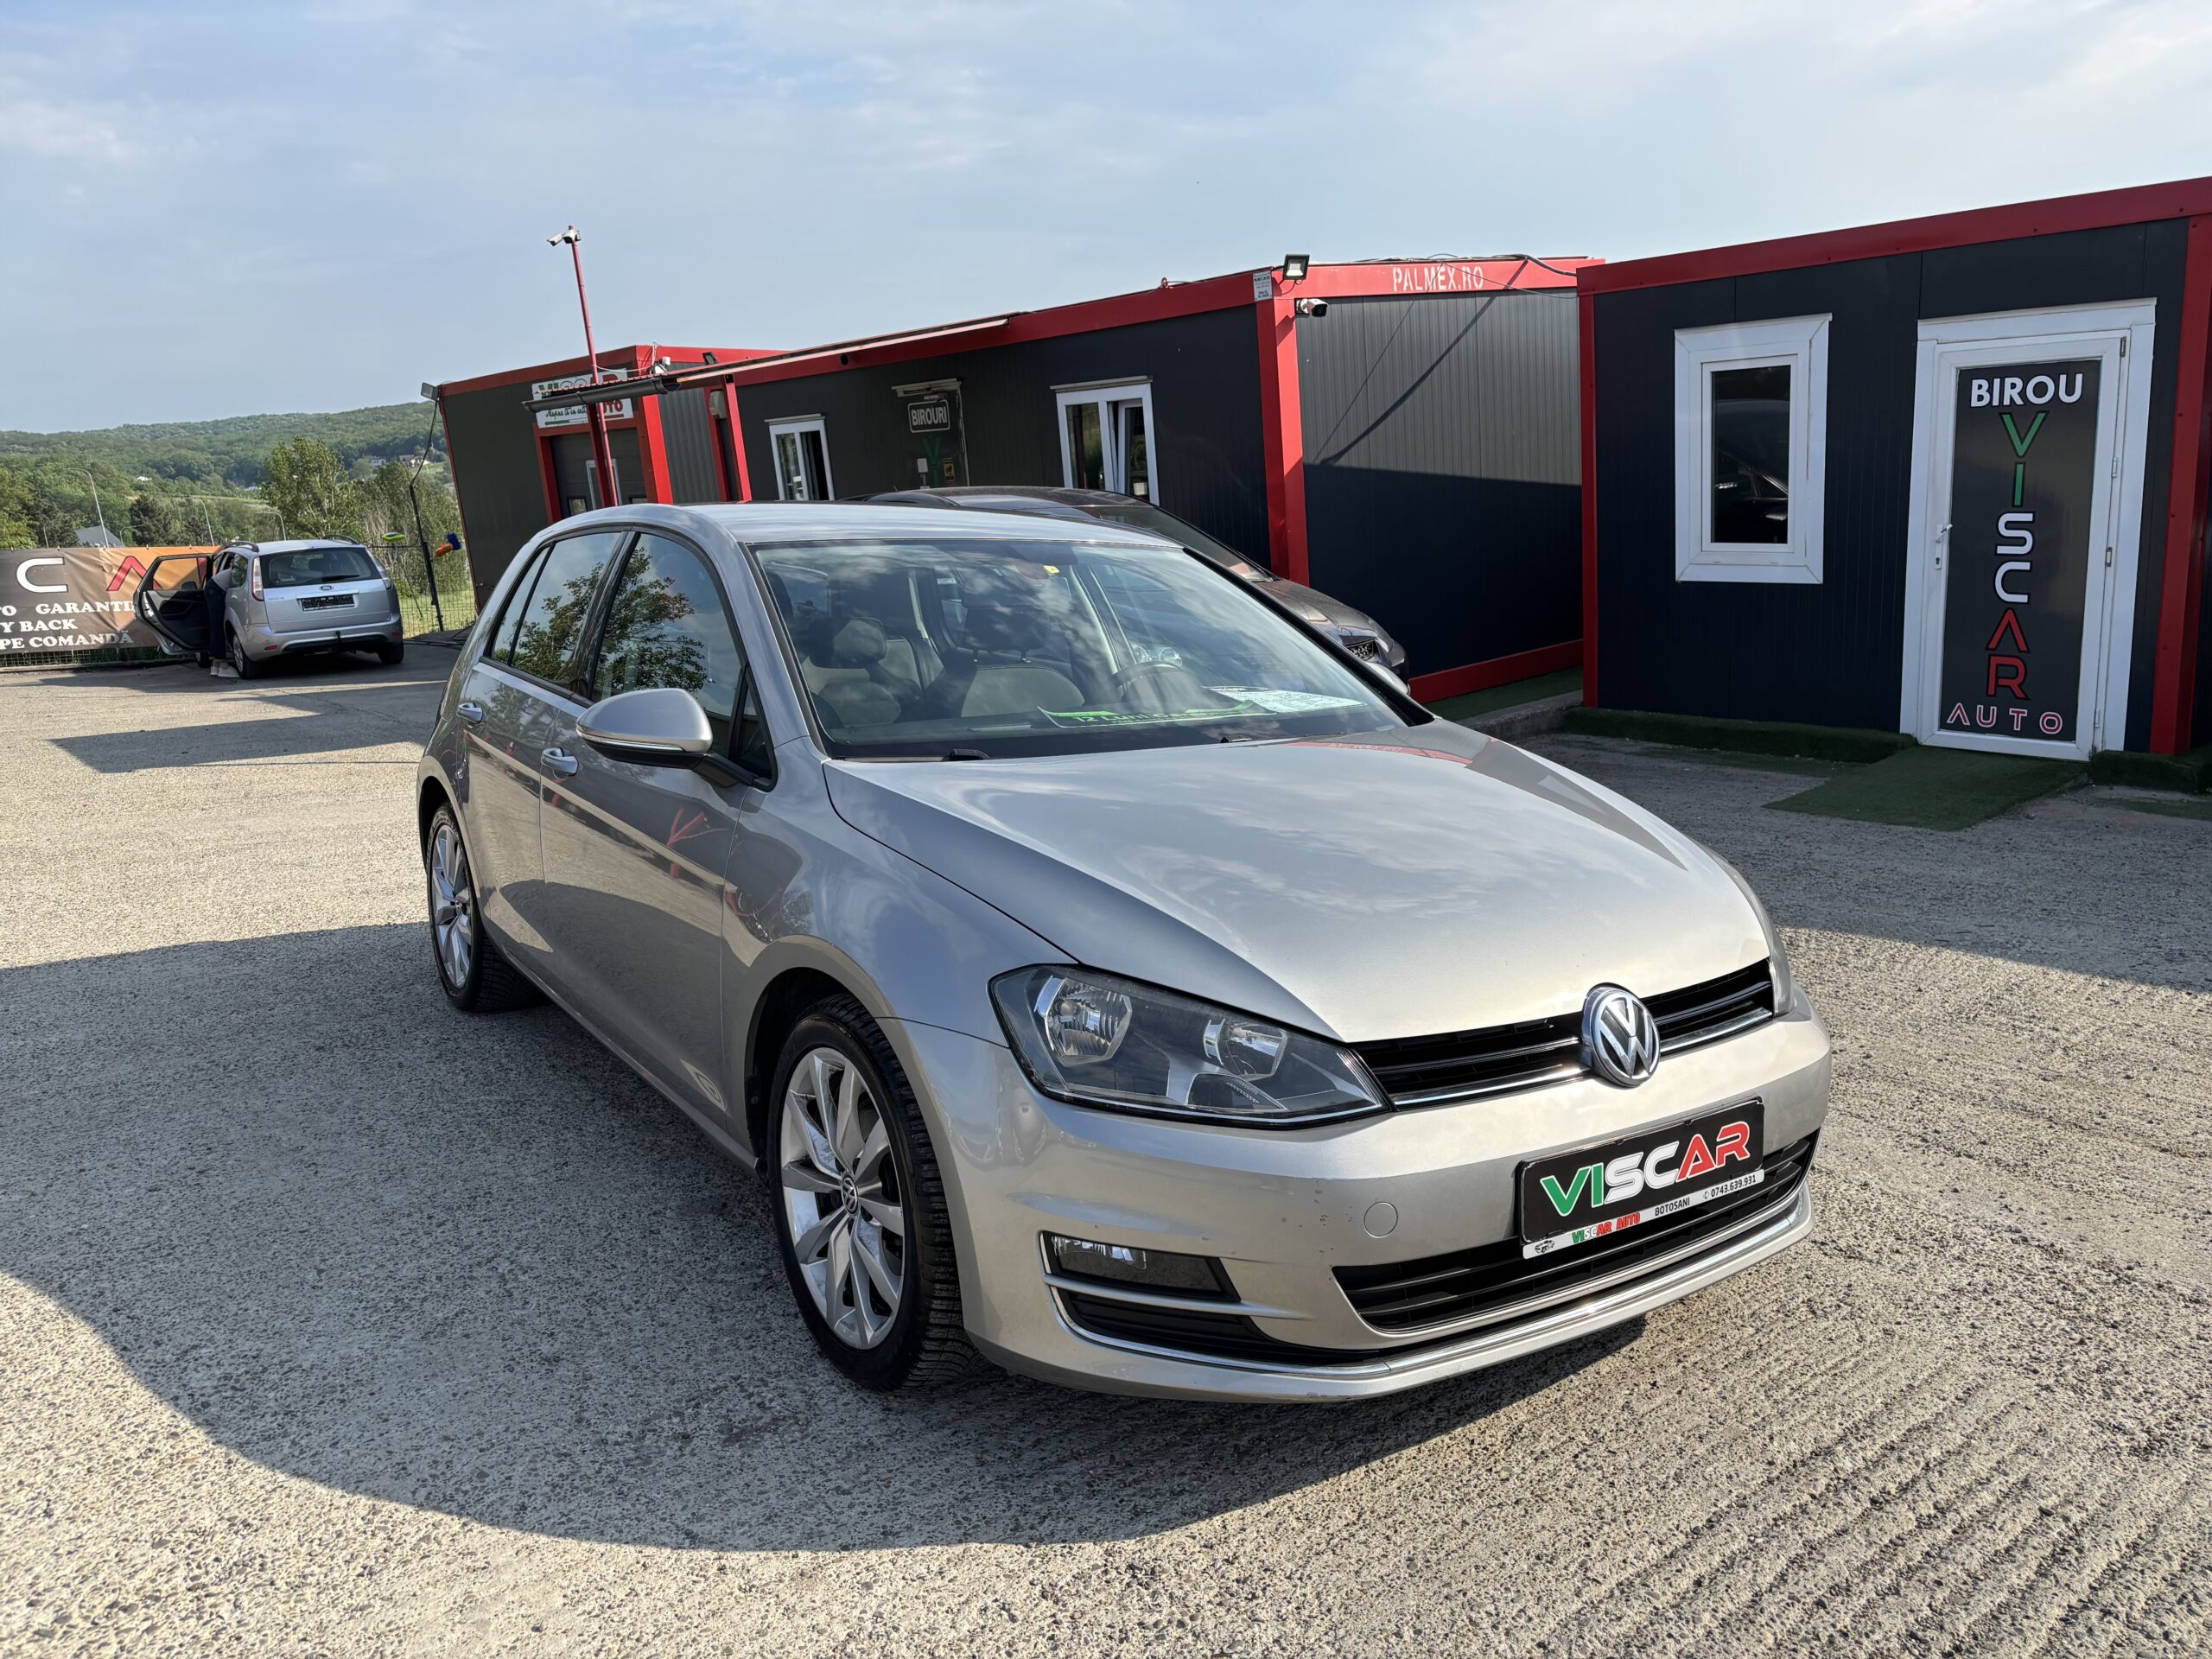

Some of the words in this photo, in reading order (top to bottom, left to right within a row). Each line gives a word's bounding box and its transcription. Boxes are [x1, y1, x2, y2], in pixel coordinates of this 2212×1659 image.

[1392, 265, 1484, 292] PALMEX.RO
[1969, 372, 2083, 408] BIROU
[911, 406, 948, 426] BIROURI
[1986, 410, 2049, 701] VISCAR
[0, 605, 16, 616] O
[0, 638, 24, 650] PE
[29, 630, 134, 648] COMANDĂ
[19, 619, 79, 632] BACK
[1947, 703, 2063, 734] AUTO
[1540, 1121, 1751, 1217] VISCAR
[1572, 1221, 1612, 1244] VISCAR
[1616, 1211, 1641, 1230] AUTO
[1655, 1197, 1690, 1217] BOTOSANI
[1711, 1174, 1757, 1198] 0743.639.931
